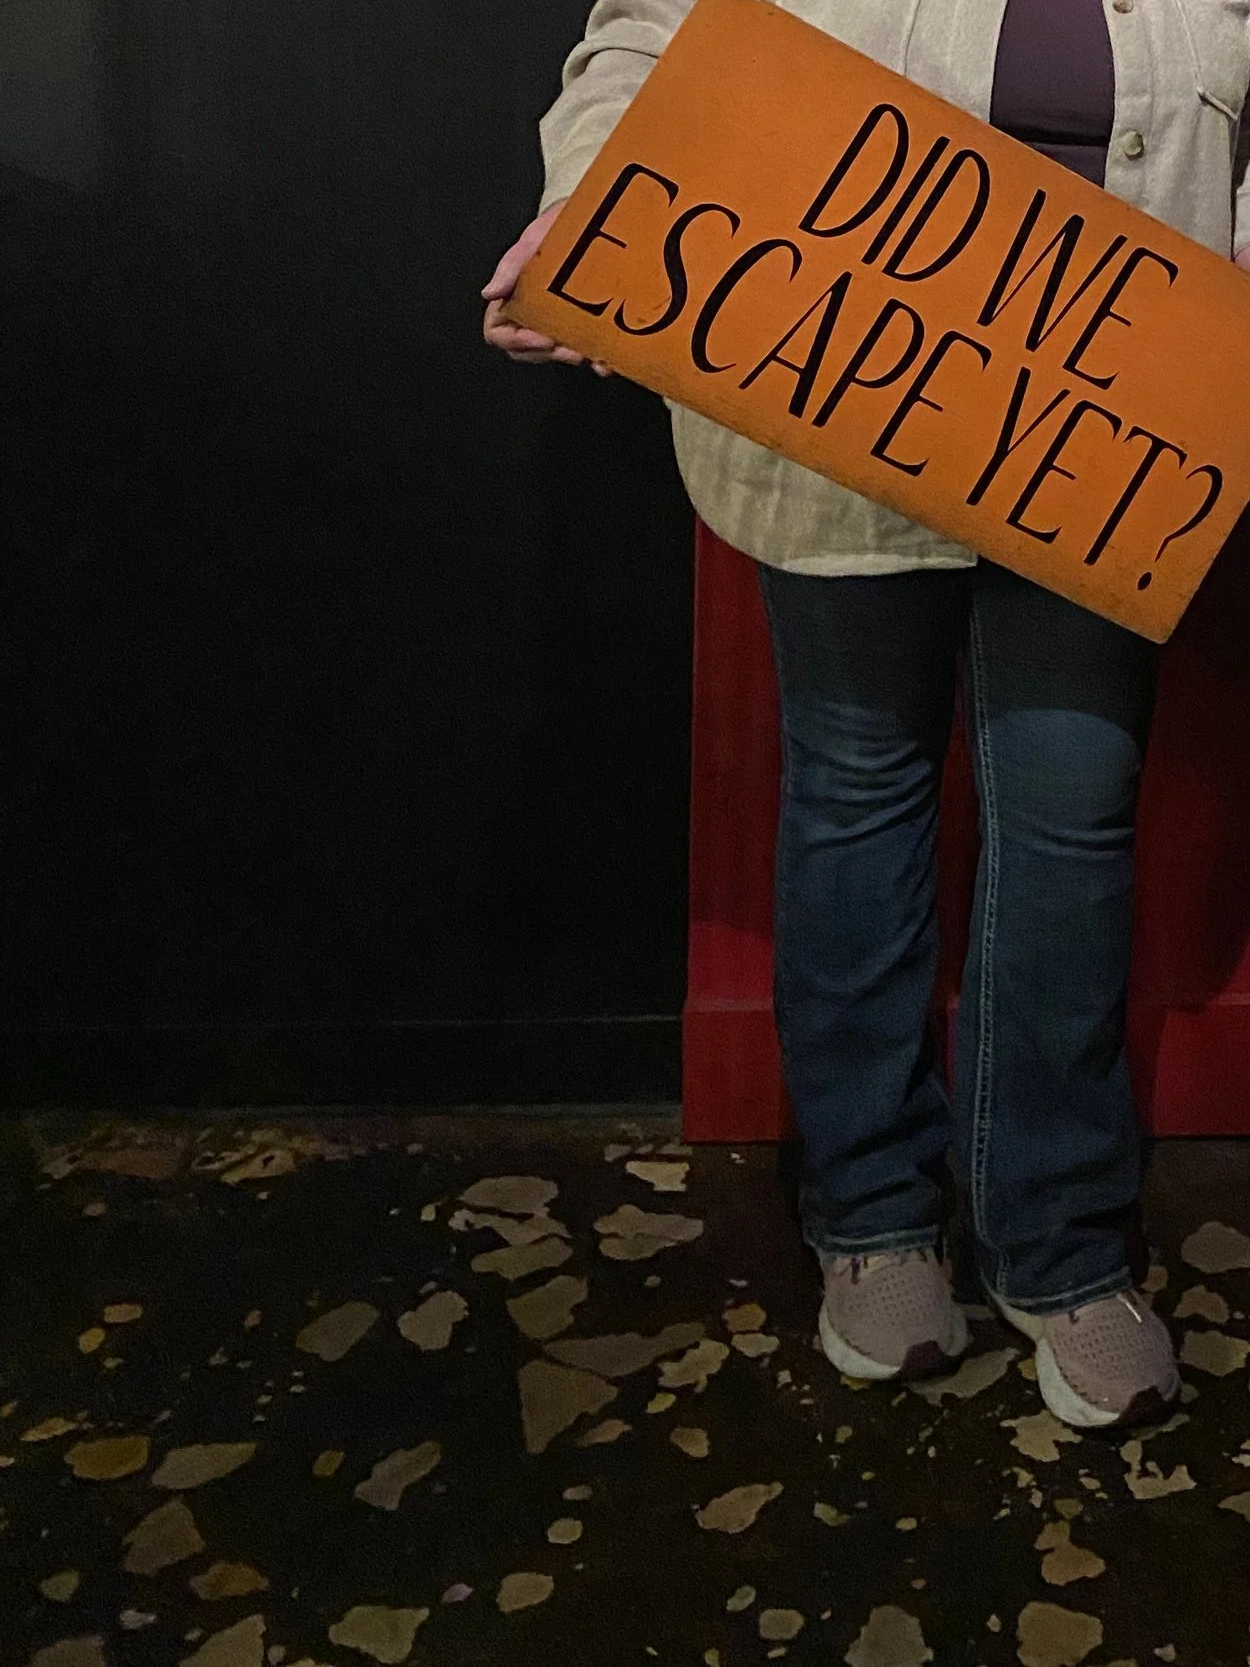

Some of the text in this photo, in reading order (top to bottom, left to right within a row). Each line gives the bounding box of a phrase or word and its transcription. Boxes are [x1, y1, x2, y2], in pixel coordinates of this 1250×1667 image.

[547, 163, 1225, 592] ESCAPE YET?
[798, 103, 1179, 390] DID WE
